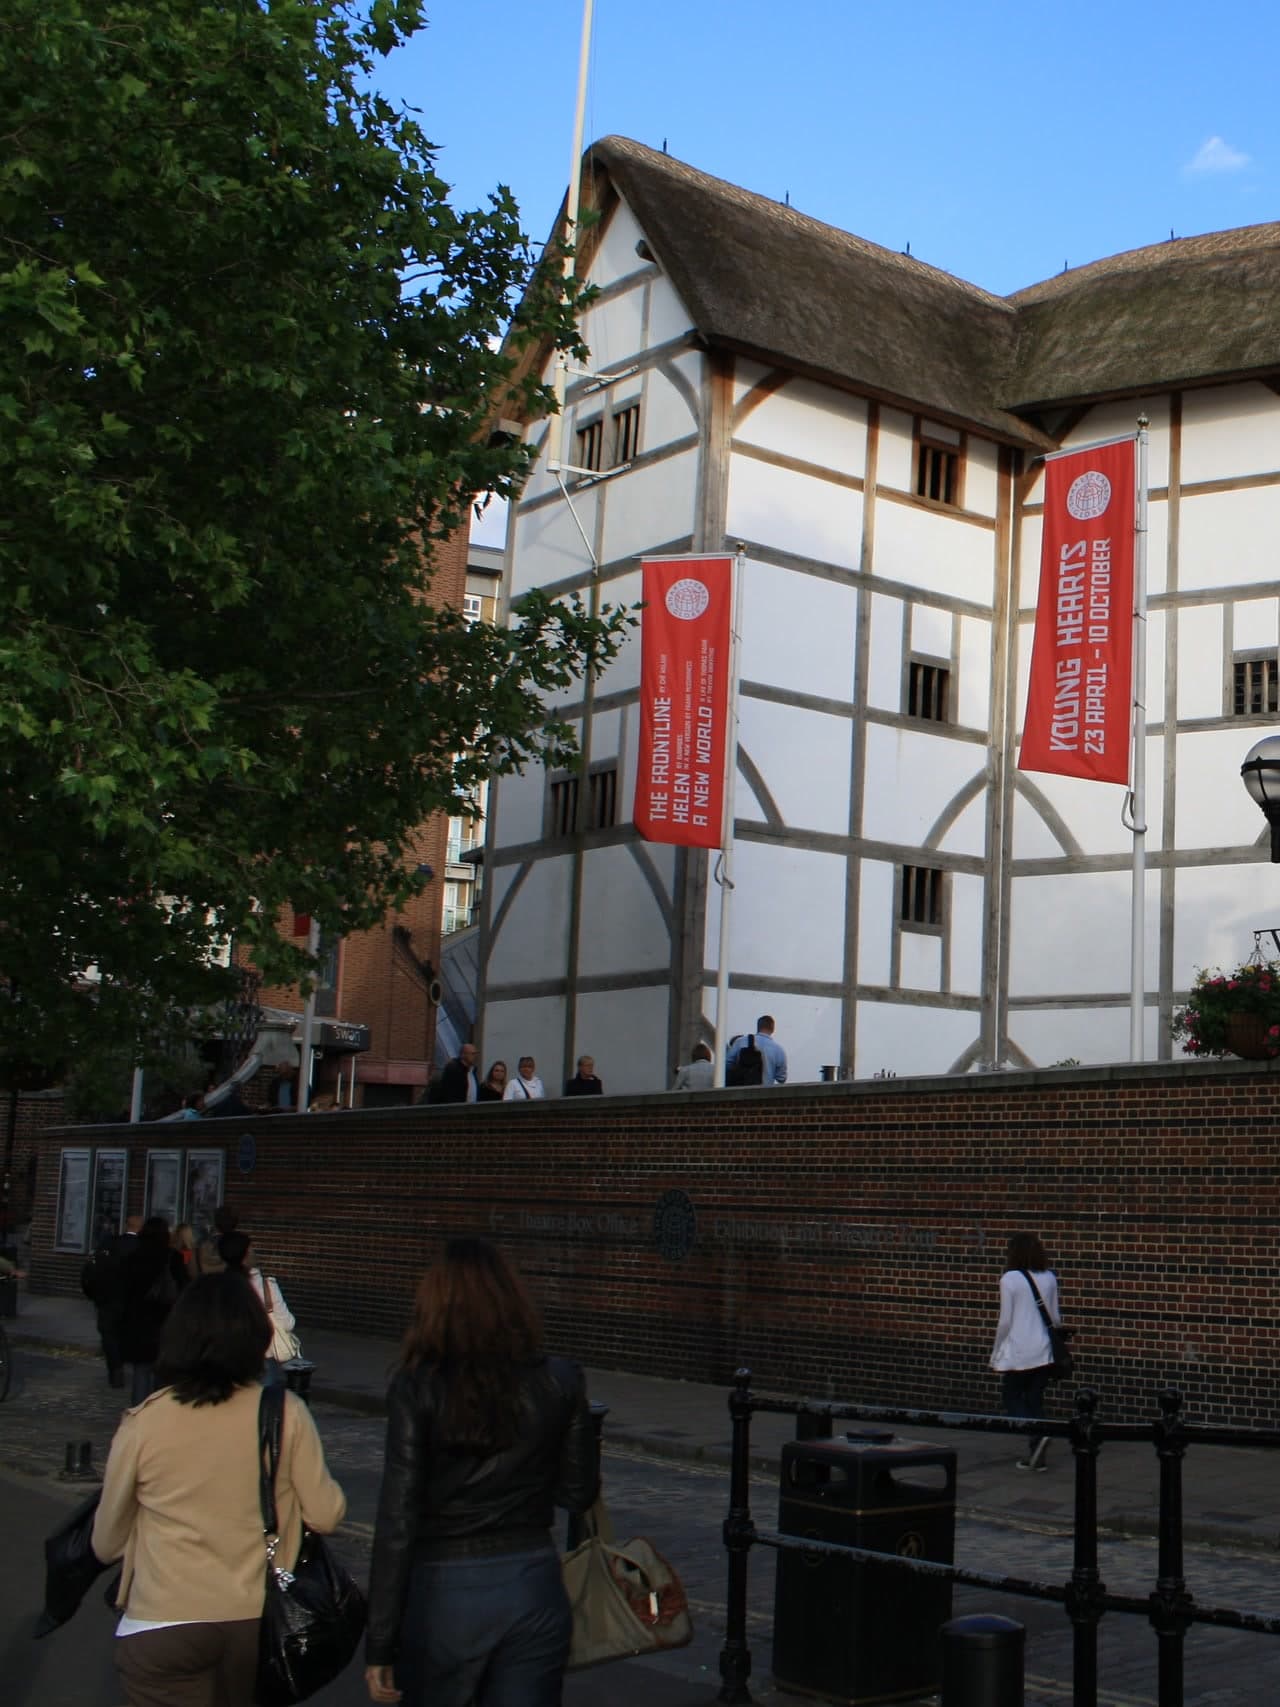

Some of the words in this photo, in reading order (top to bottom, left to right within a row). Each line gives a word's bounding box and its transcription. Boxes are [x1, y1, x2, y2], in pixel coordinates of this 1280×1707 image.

[1056, 540, 1087, 647] HEARTS
[1088, 537, 1111, 621] OCTOBER
[1087, 625, 1109, 644] 10
[1049, 658, 1081, 751] YOUNG
[1085, 663, 1107, 724] APRIL
[651, 697, 671, 784] FRONTLINE
[696, 706, 712, 763] WORLD
[1084, 730, 1105, 755] 23
[649, 792, 668, 821] THE
[672, 773, 690, 823] HELEN
[694, 772, 709, 807] NEW
[693, 814, 708, 826] A
